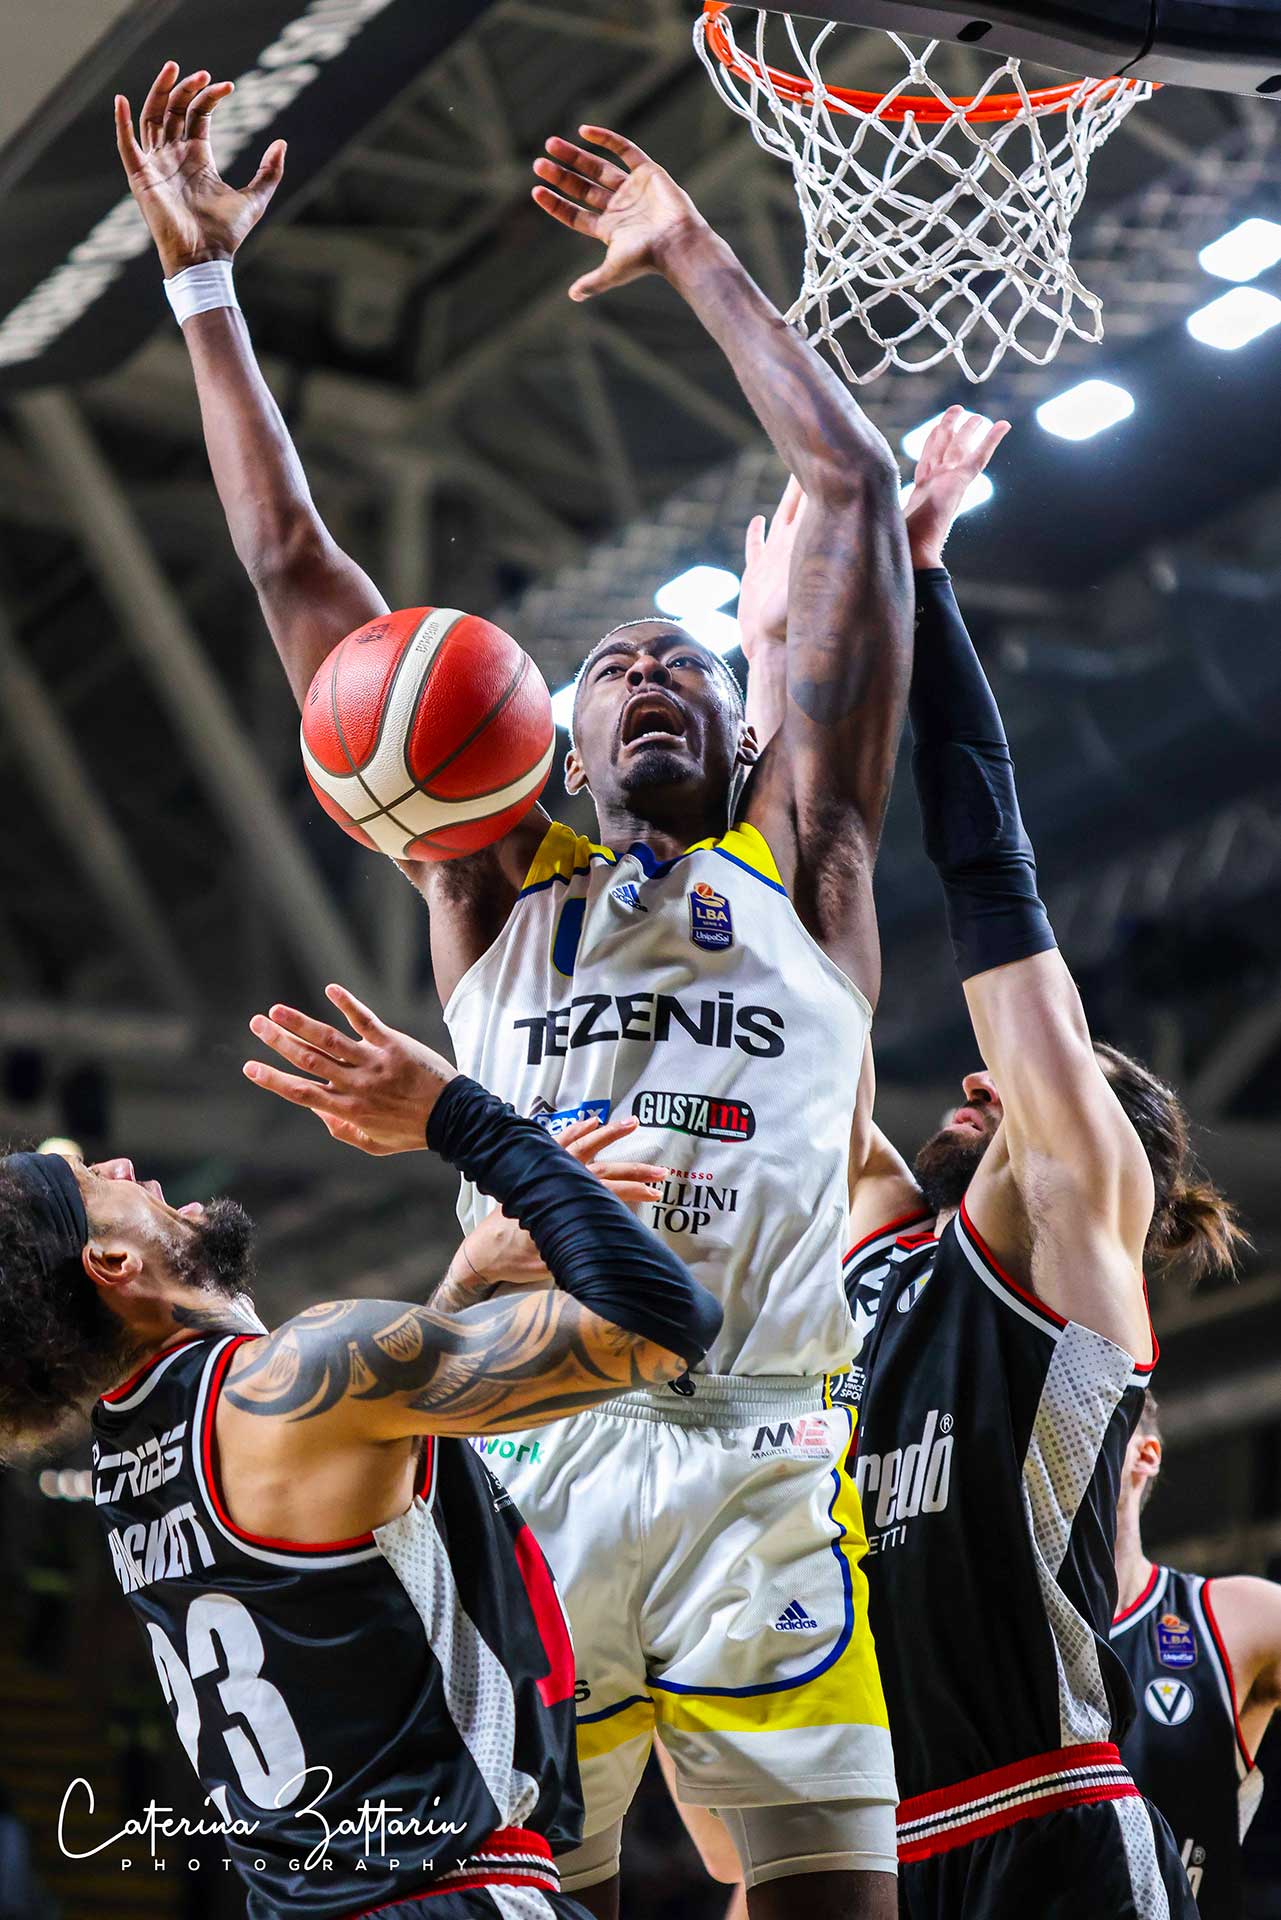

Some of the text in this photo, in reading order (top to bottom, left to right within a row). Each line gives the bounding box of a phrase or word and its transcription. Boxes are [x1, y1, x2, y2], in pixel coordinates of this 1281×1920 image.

[696, 907, 728, 922] LBA
[661, 1166, 714, 1180] PRESSO
[645, 1180, 738, 1211] LLINI
[652, 1205, 711, 1234] TOP
[775, 1618, 818, 1630] adidas
